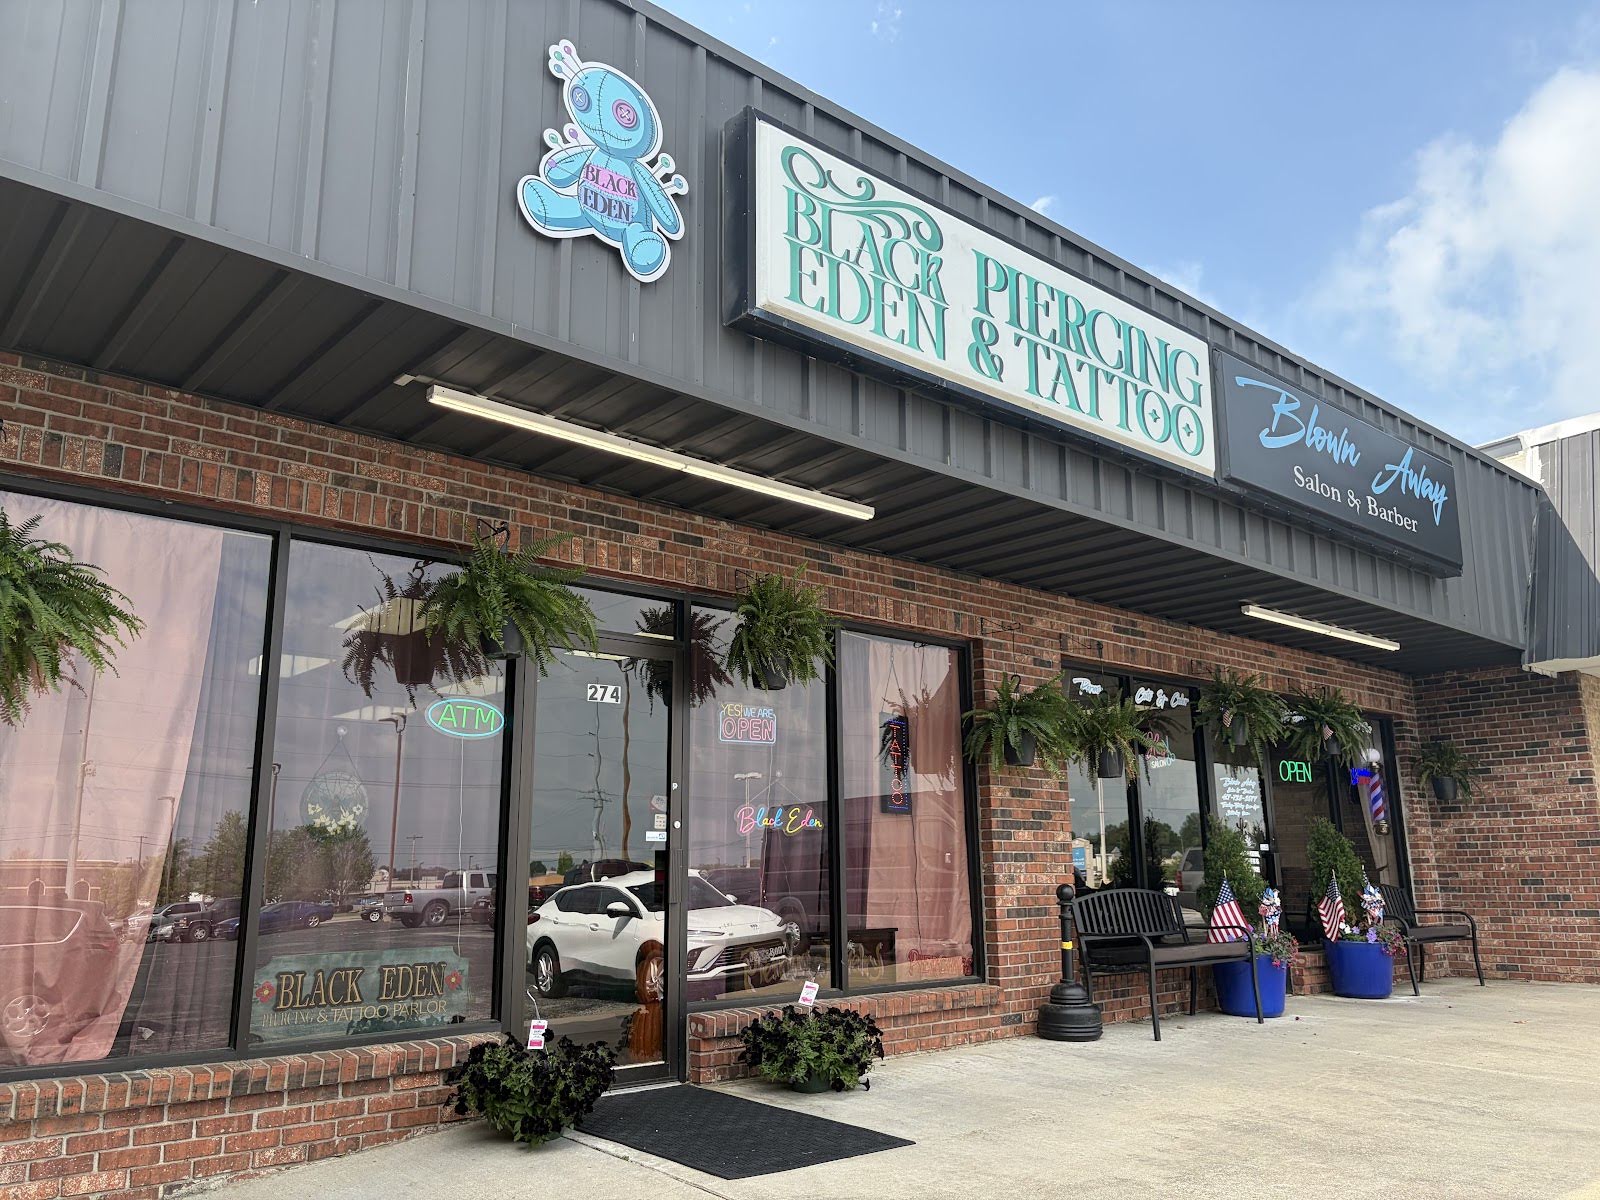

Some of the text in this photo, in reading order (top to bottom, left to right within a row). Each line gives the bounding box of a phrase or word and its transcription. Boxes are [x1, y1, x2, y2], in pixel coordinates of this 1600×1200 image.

[585, 163, 637, 198] BLACK
[583, 187, 631, 221] EDEN
[782, 185, 950, 307] BLACK
[784, 237, 949, 360] EDEN
[971, 248, 1203, 407] PIERCING
[967, 316, 1205, 457] & TATTOO
[1235, 376, 1448, 526] Blown Away
[1293, 465, 1418, 533] Salon & Barber
[588, 685, 620, 702] 274
[437, 703, 496, 732] ATM
[722, 717, 775, 741] OPEN
[757, 708, 774, 718] ARE
[889, 724, 904, 805] TATTOO
[1279, 760, 1312, 783] OPEN
[736, 806, 823, 834] Black Eden
[275, 963, 448, 1010] BLACK EDEN
[262, 1000, 448, 1028] PIERCING & TATTOO PARLOR
